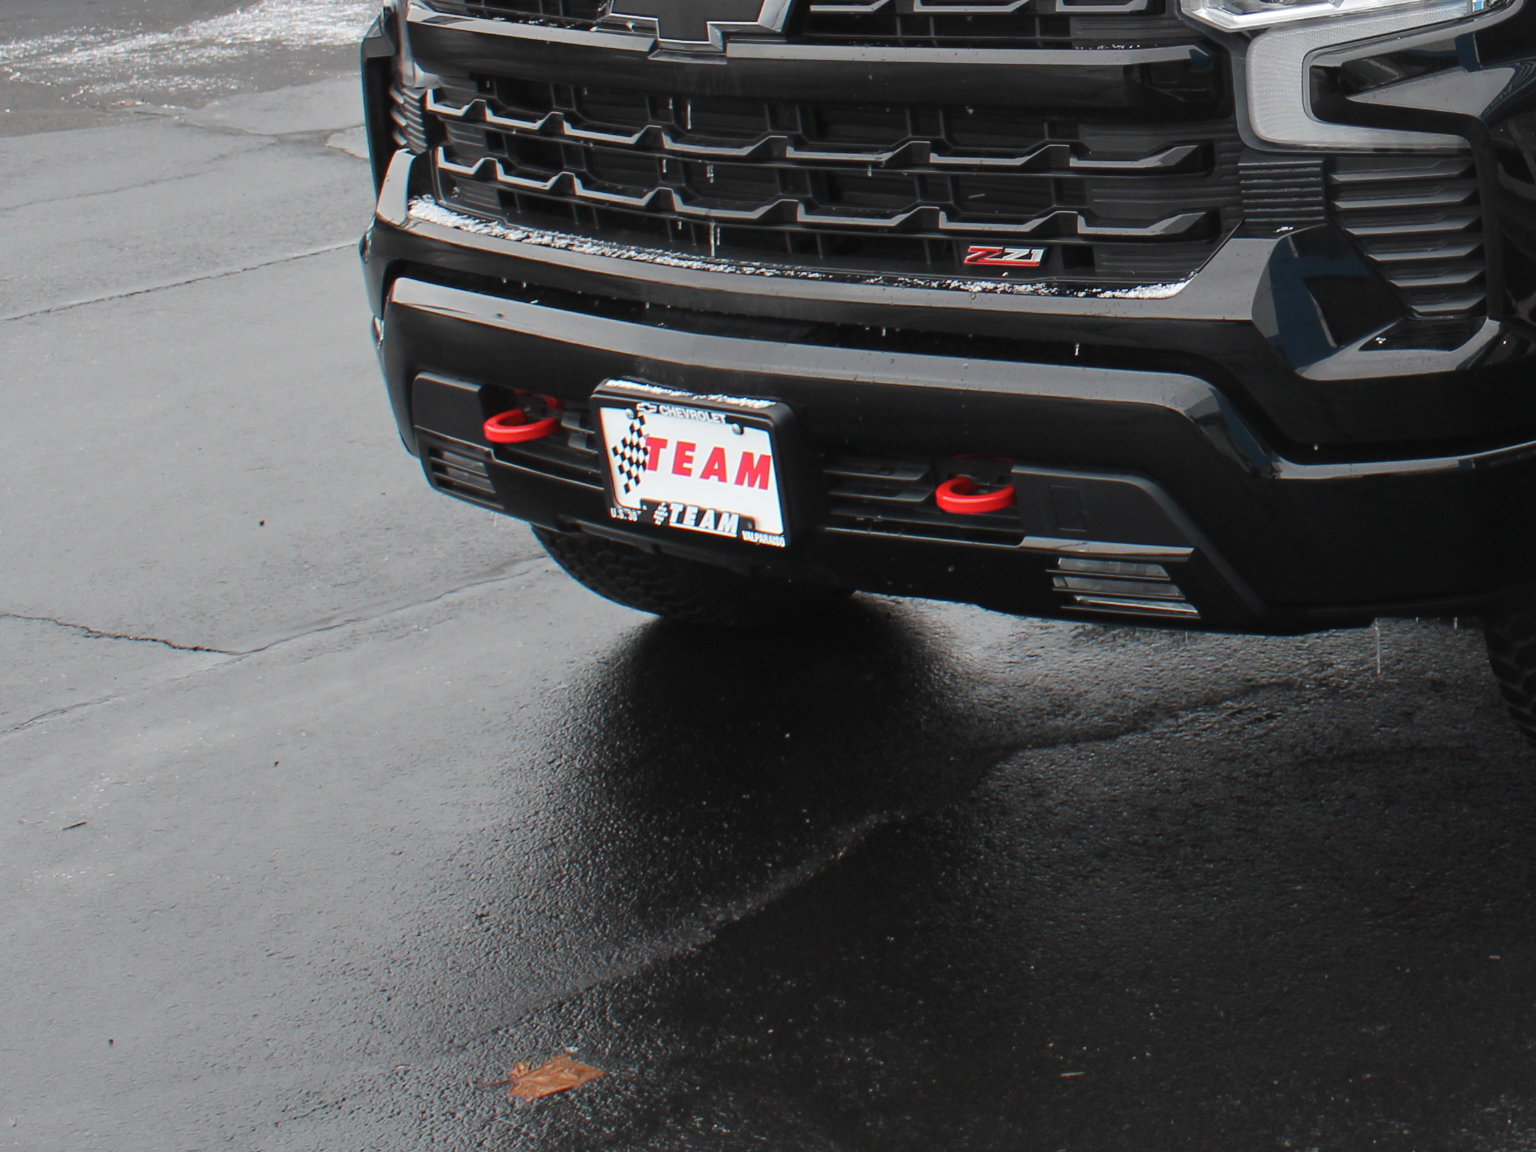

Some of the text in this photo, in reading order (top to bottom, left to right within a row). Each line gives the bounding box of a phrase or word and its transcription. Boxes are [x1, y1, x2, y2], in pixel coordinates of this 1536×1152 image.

[964, 246, 1045, 267] Z71
[658, 405, 727, 425] CHEVROLET
[645, 436, 771, 491] TEAM
[668, 502, 740, 535] TEAM
